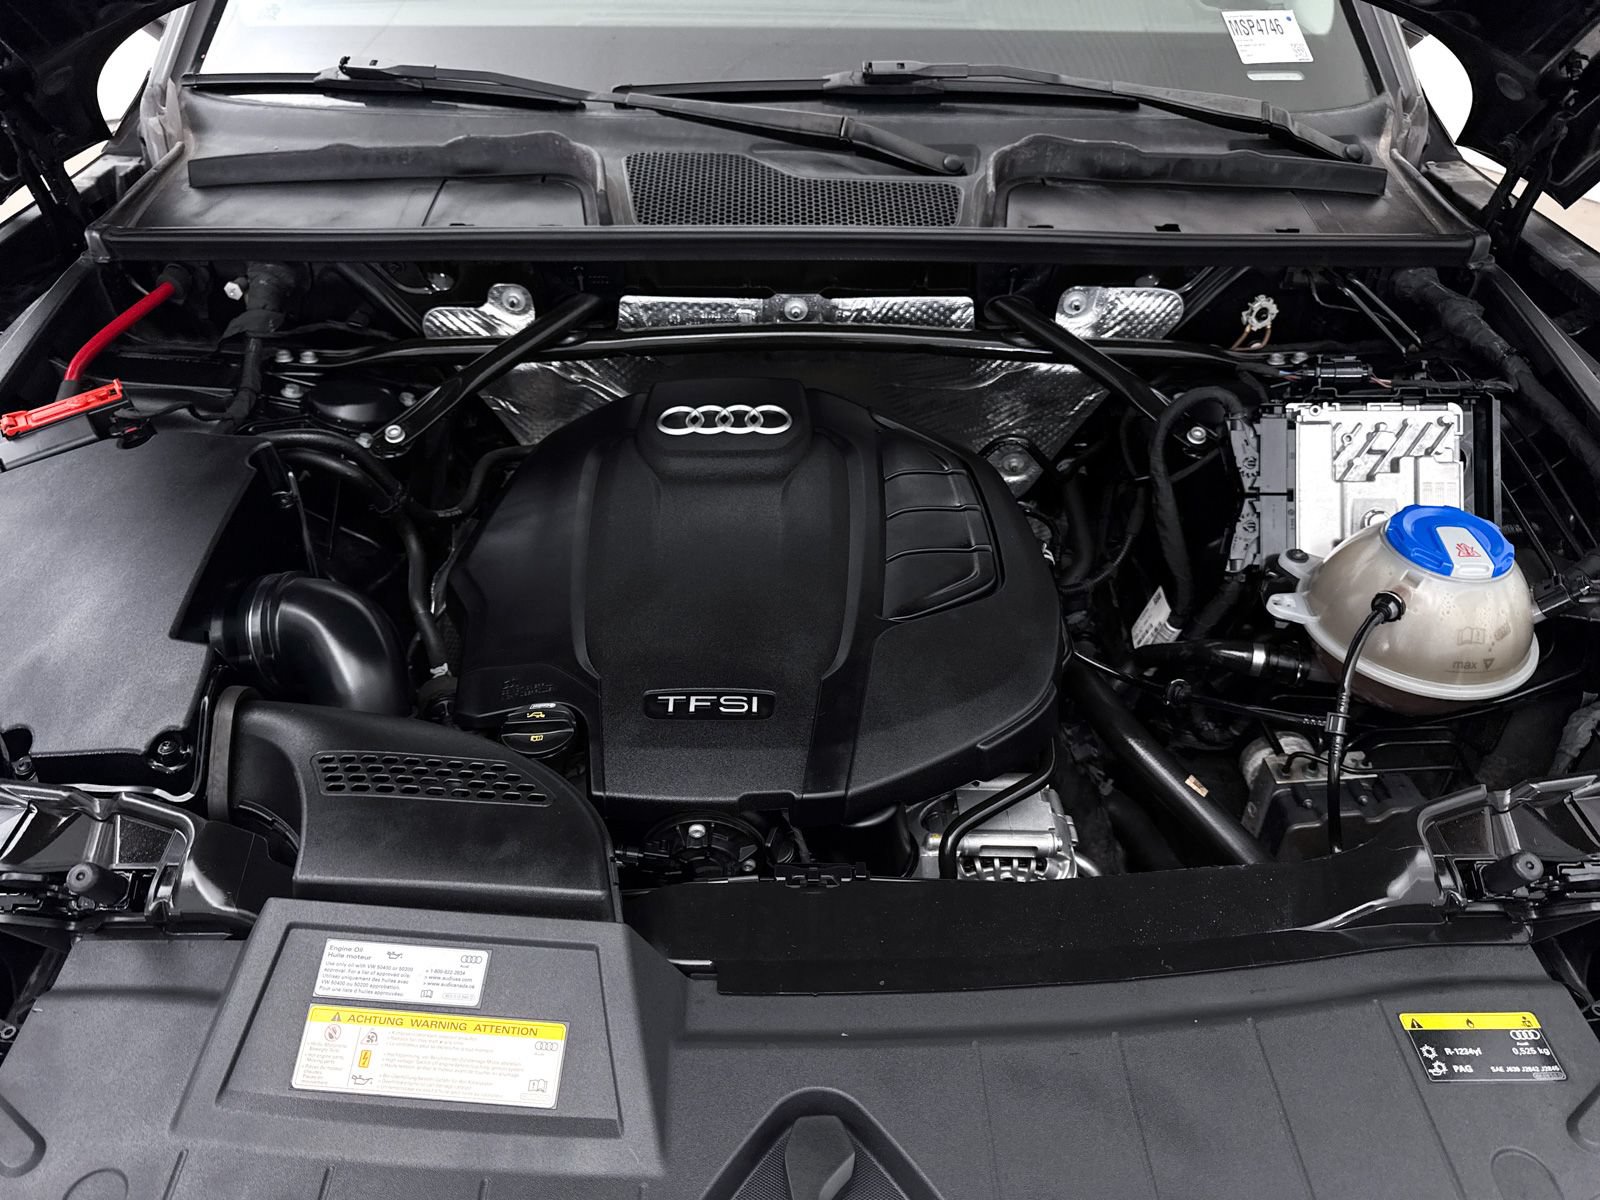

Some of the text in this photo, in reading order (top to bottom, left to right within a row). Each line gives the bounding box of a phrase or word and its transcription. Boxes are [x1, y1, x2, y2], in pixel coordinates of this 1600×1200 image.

[1228, 18, 1284, 36] MSP4746
[1452, 660, 1477, 670] max
[657, 696, 758, 713] TFSI
[347, 1014, 538, 1036] ACHTUNG WARNING ATTENTION
[1444, 1047, 1550, 1056] R-1234yf 0,525 kg
[1453, 1064, 1474, 1073] PAG
